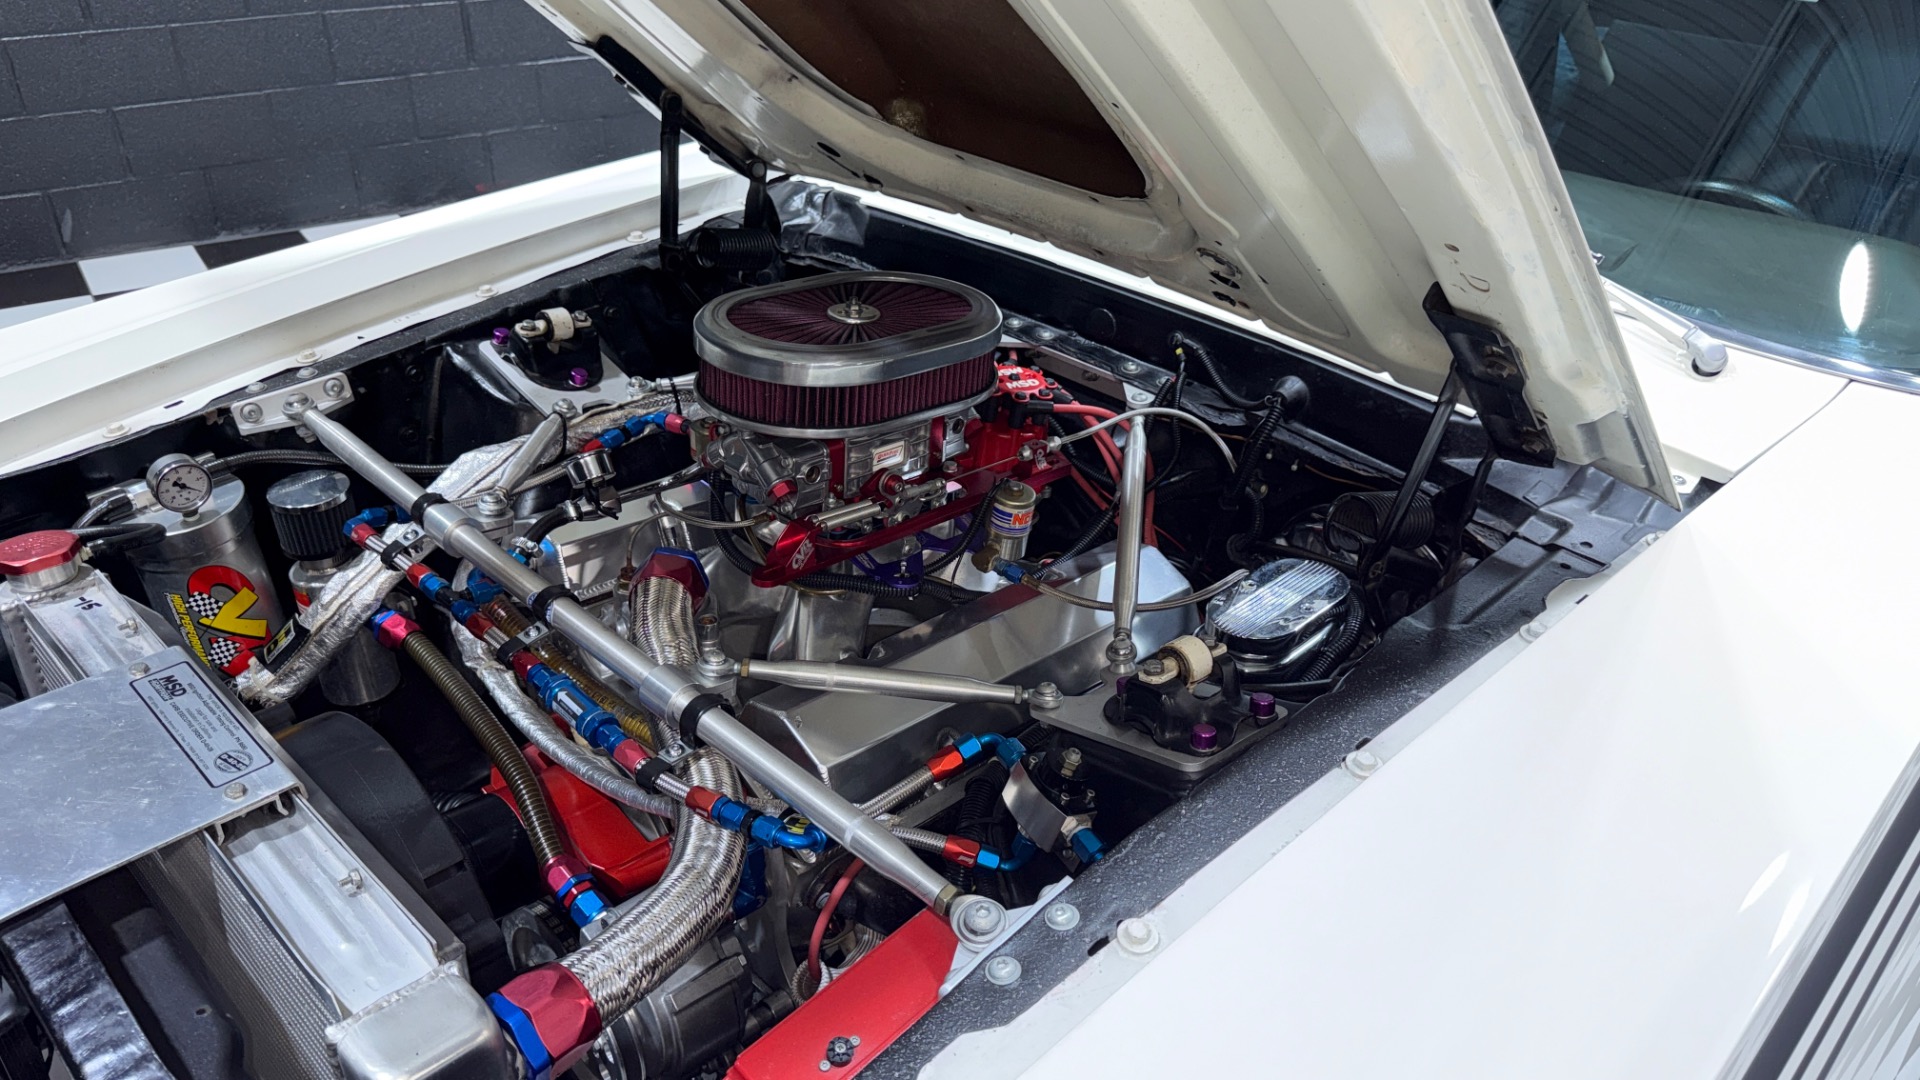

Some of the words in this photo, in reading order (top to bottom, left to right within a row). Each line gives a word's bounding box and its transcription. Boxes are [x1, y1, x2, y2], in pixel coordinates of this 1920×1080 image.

[1005, 379, 1040, 390] MSD
[1011, 511, 1034, 526] NO
[791, 538, 813, 570] CVR
[170, 593, 187, 613] HIGH
[158, 674, 187, 697] MSD
[168, 701, 181, 712] CARB
[175, 709, 195, 729] EXECUTIVE
[190, 726, 205, 740] ORDER
